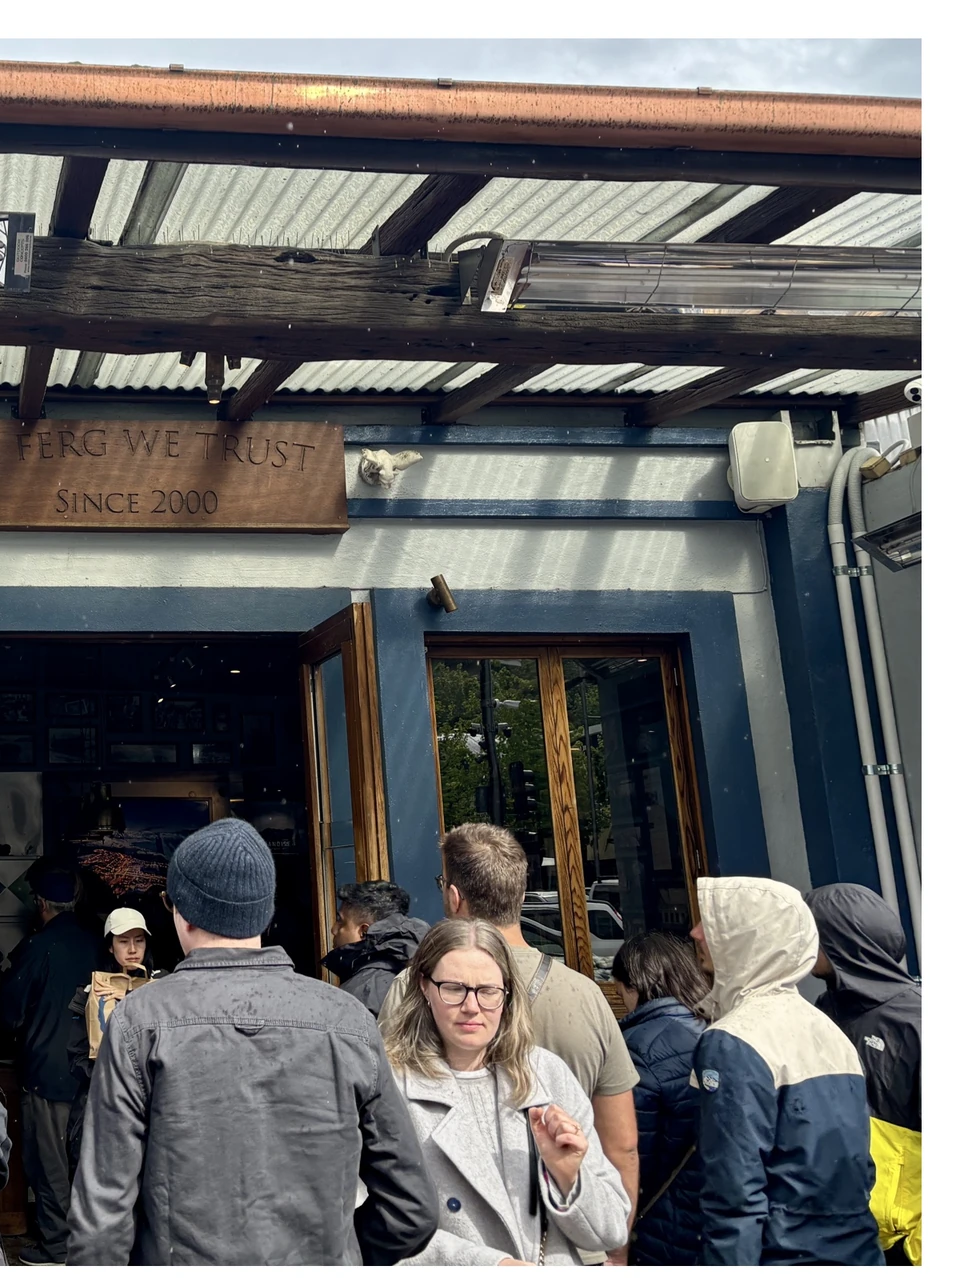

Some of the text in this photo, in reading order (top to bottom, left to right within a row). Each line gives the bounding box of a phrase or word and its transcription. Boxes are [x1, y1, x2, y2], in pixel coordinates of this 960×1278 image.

[16, 429, 108, 461] FERG
[122, 429, 180, 458] WE
[195, 431, 316, 472] TRUST
[150, 489, 219, 515] 2000
